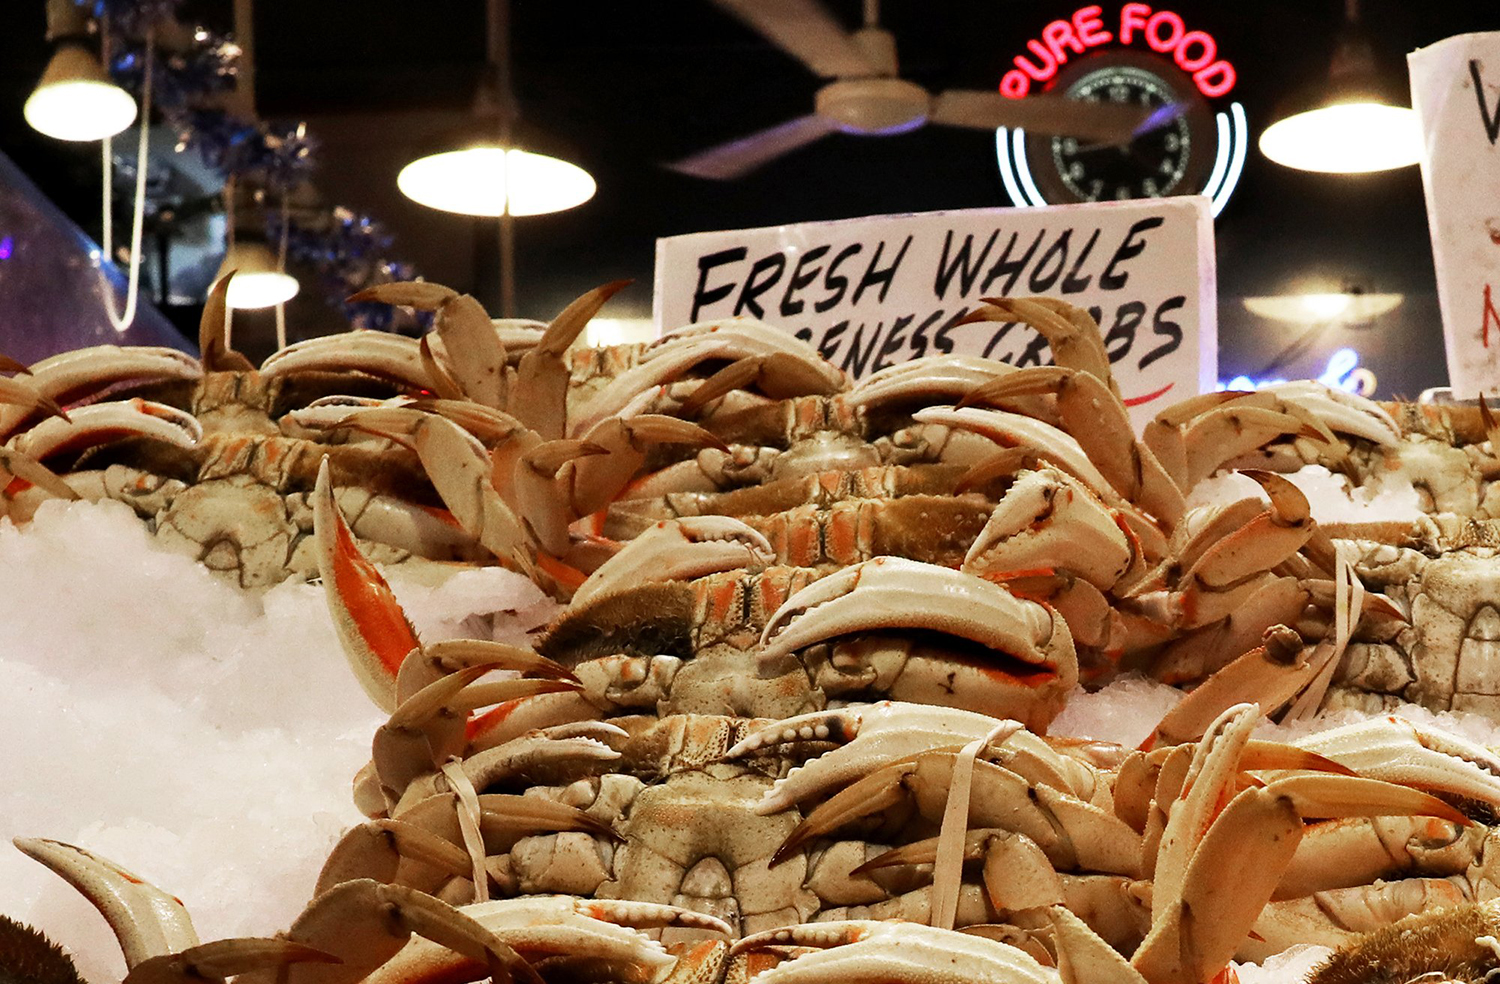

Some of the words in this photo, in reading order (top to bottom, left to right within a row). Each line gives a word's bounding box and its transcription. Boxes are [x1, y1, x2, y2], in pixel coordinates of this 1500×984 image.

[999, 5, 1113, 99] PURE
[1119, 2, 1237, 97] FOOD
[690, 234, 914, 324] FRESH
[934, 216, 1164, 300] WHOLE
